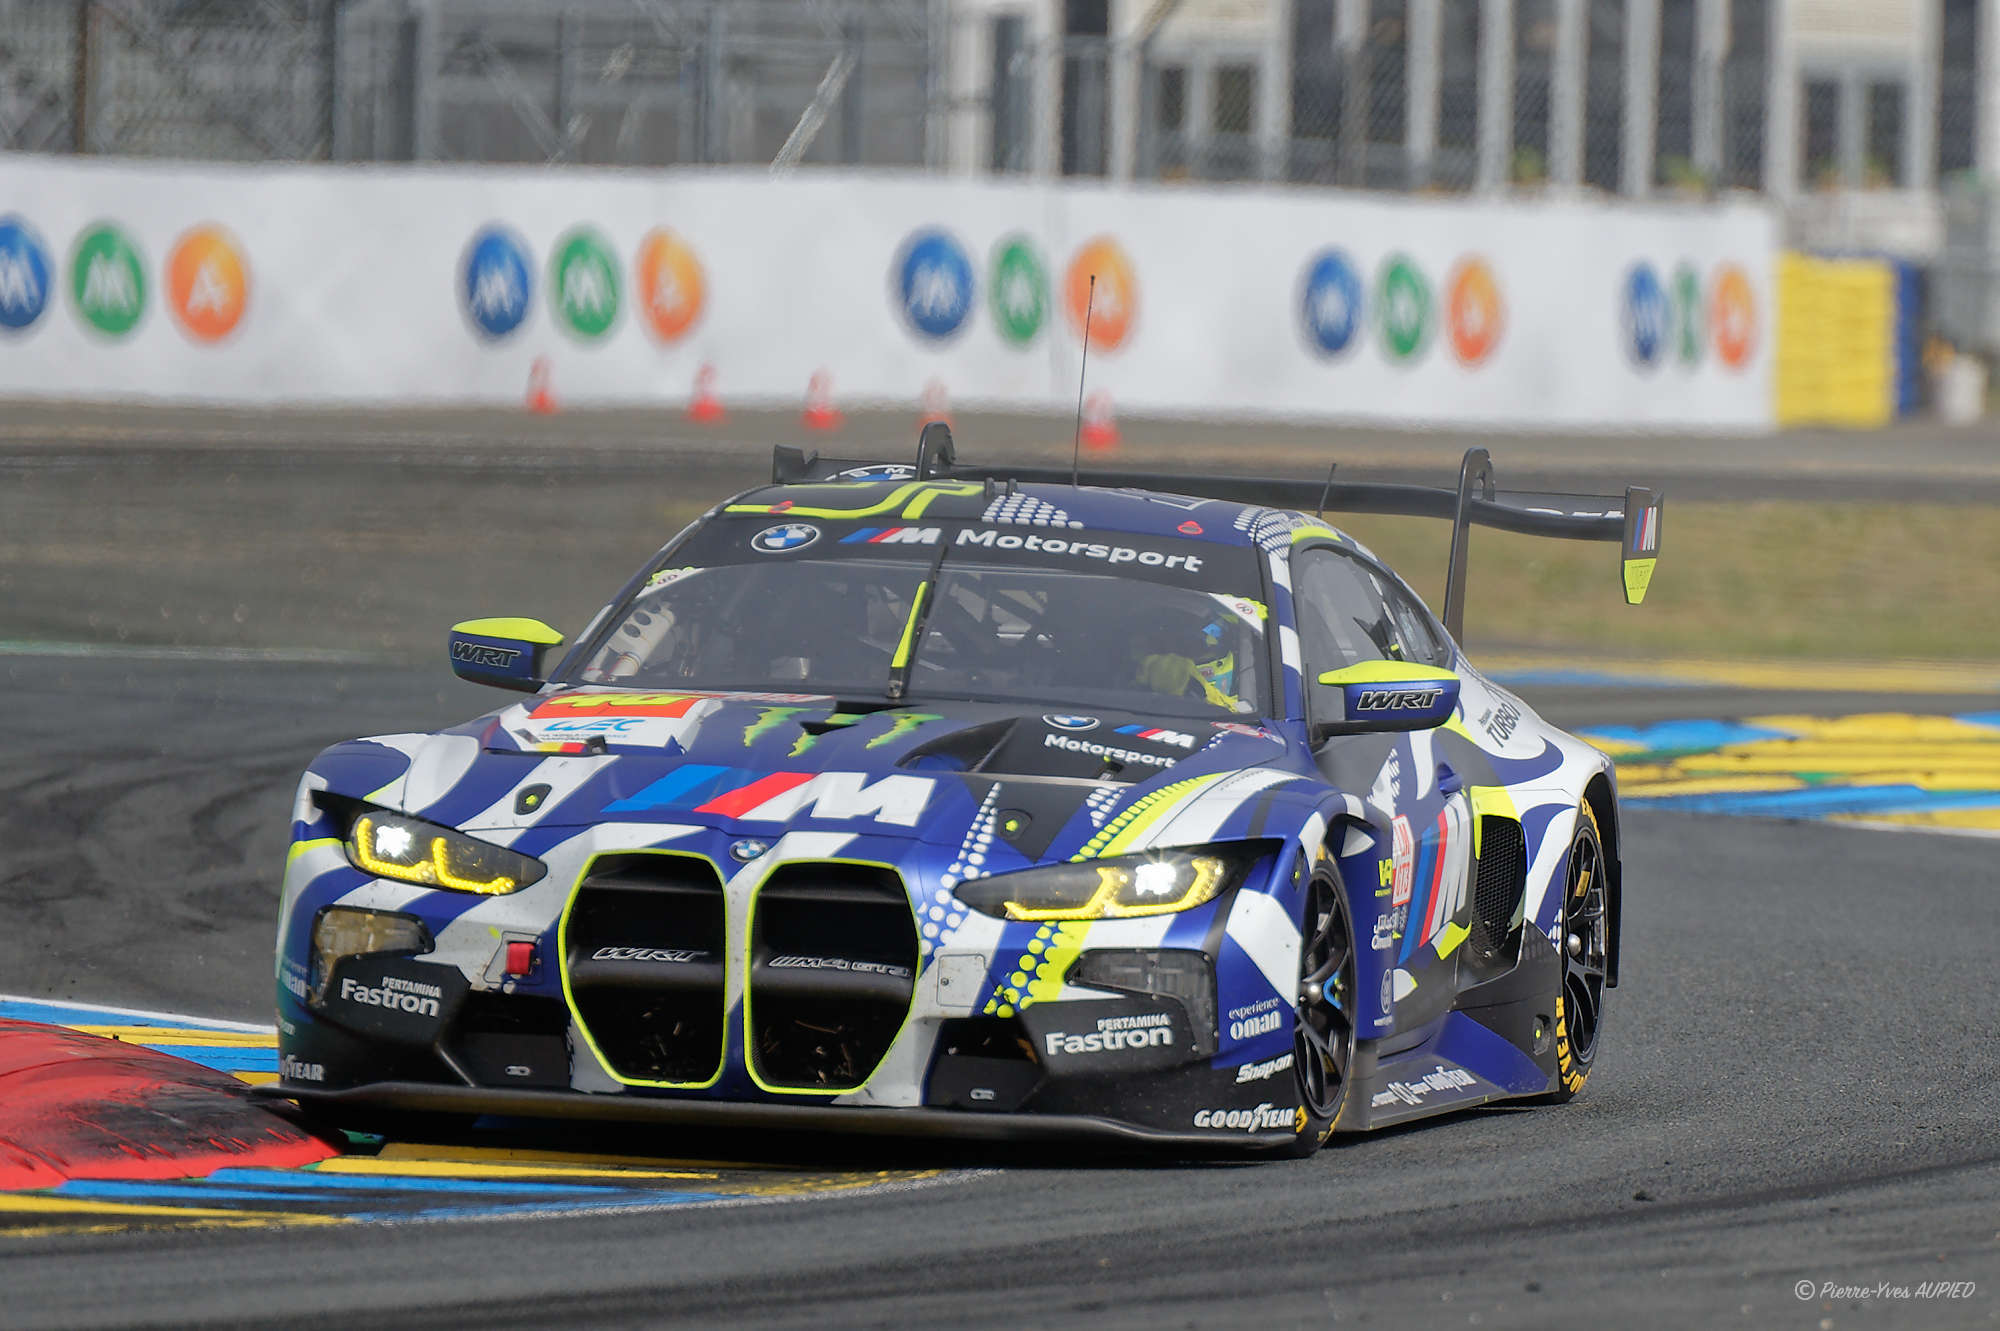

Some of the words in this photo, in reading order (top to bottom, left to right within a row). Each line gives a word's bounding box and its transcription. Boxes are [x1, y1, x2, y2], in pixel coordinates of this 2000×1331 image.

[955, 528, 1204, 573] Motorsport
[452, 640, 522, 668] WRT
[1356, 687, 1444, 711] WRT
[1044, 733, 1176, 769] Motorsport
[592, 947, 708, 963] WRT
[341, 978, 440, 1018] Fastron
[382, 976, 442, 998] PERTAMINA
[1097, 1013, 1171, 1031] PERTAMINA
[1228, 997, 1280, 1020] experience
[1230, 1011, 1282, 1040] oman
[1046, 1027, 1174, 1056] Fastron
